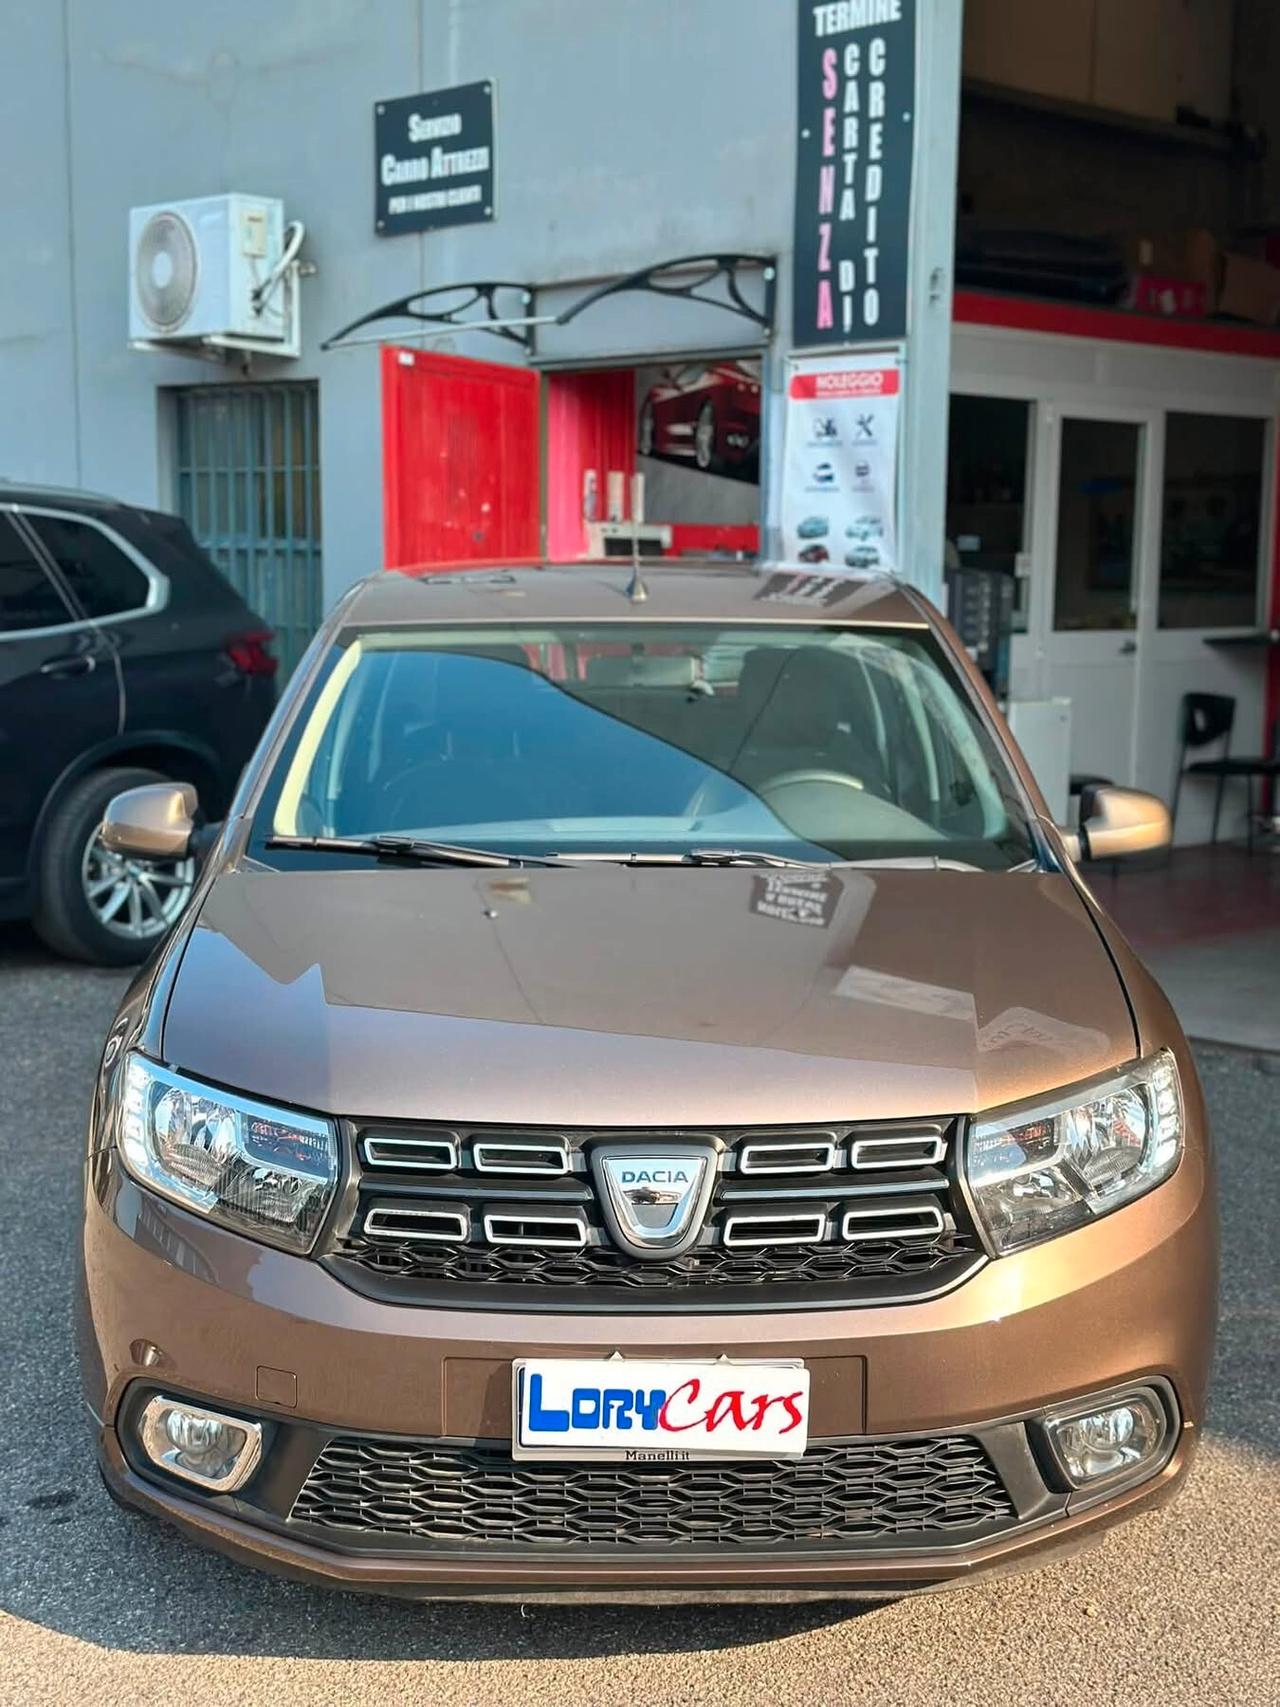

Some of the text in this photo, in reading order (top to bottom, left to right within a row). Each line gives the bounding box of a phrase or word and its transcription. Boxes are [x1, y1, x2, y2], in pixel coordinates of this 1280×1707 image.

[813, 0, 902, 37] TERMINE
[817, 47, 838, 330] SENZA
[838, 42, 861, 333] CARTA DI
[863, 37, 886, 327] CREDITO
[621, 1171, 688, 1183] DACIA
